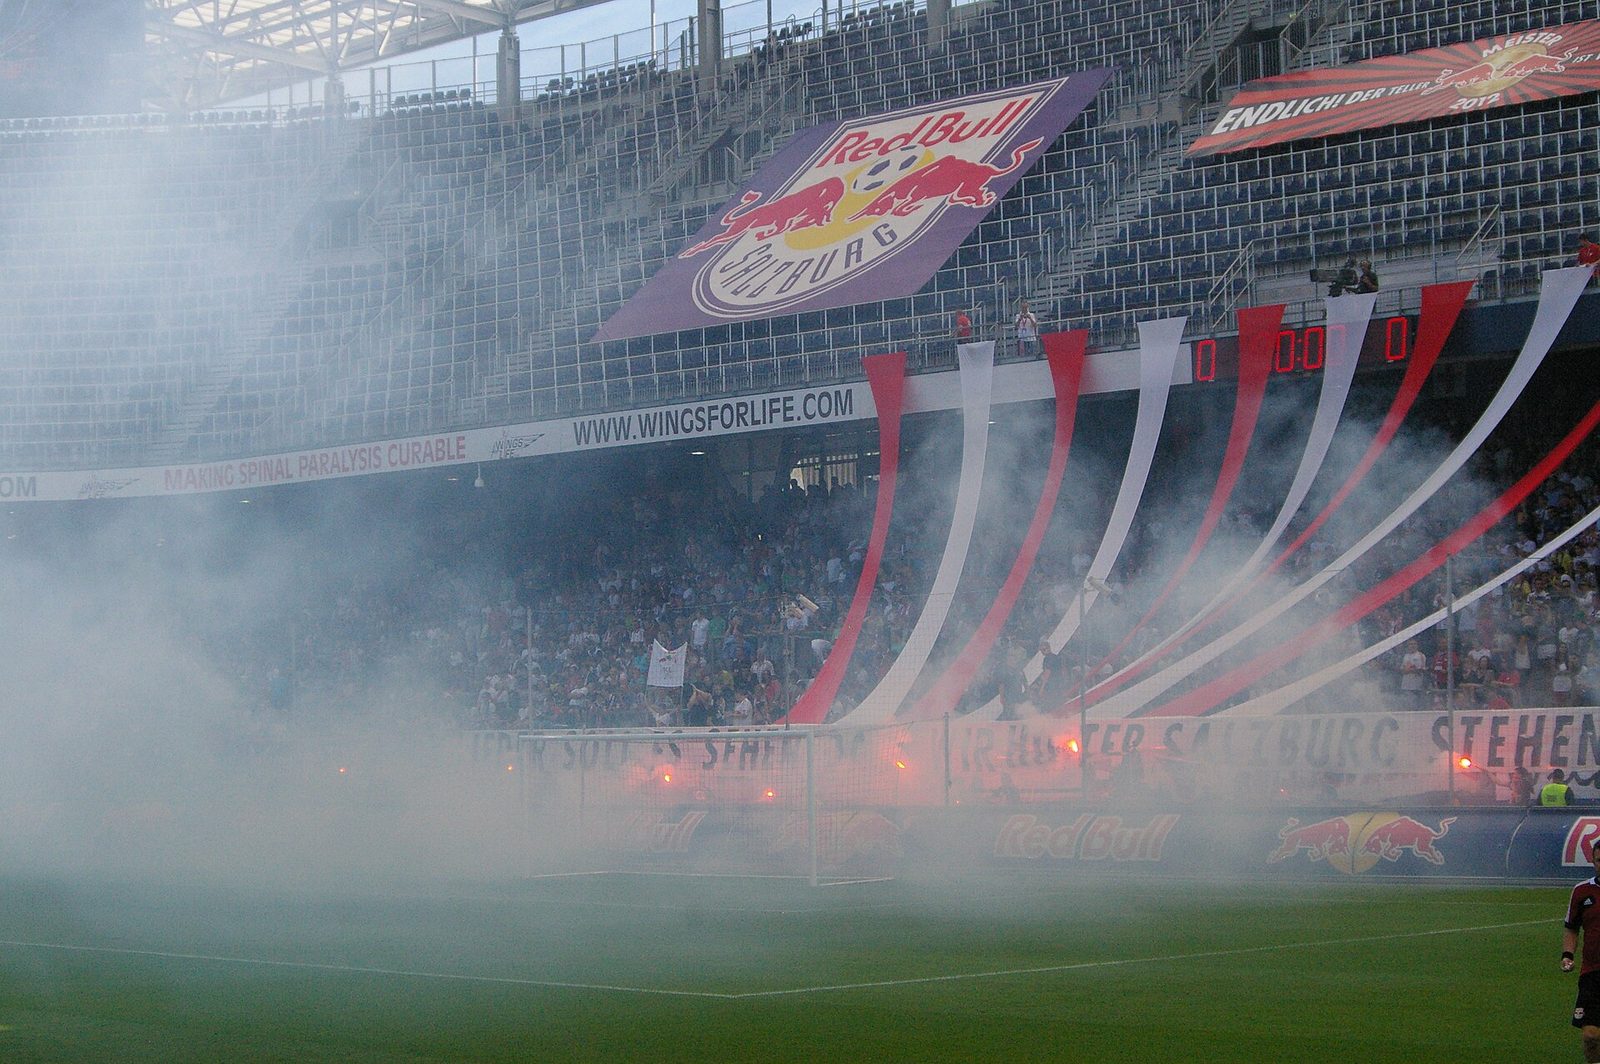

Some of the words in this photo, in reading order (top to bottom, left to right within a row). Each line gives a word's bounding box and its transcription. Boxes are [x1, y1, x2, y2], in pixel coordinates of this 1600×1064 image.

[1482, 32, 1563, 58] MEISTER
[1211, 94, 1345, 135] ENDLICH!
[1345, 87, 1387, 106] DER
[1388, 81, 1429, 96] TELLER
[1572, 54, 1594, 64] IST
[1448, 93, 1501, 110] 2012
[816, 125, 932, 168] Red
[919, 98, 1032, 147] Bull
[719, 222, 898, 299] SALZBURG
[574, 389, 853, 446] WWW.WINGSFORLIFE.COM
[164, 463, 235, 490] MAKING
[239, 456, 293, 484] SPINAL
[300, 445, 382, 475] PARALYSIS
[387, 435, 466, 466] CURABLE
[1431, 713, 1600, 769] STEHEN
[994, 813, 1096, 859] Red
[1078, 813, 1182, 862] Bull
